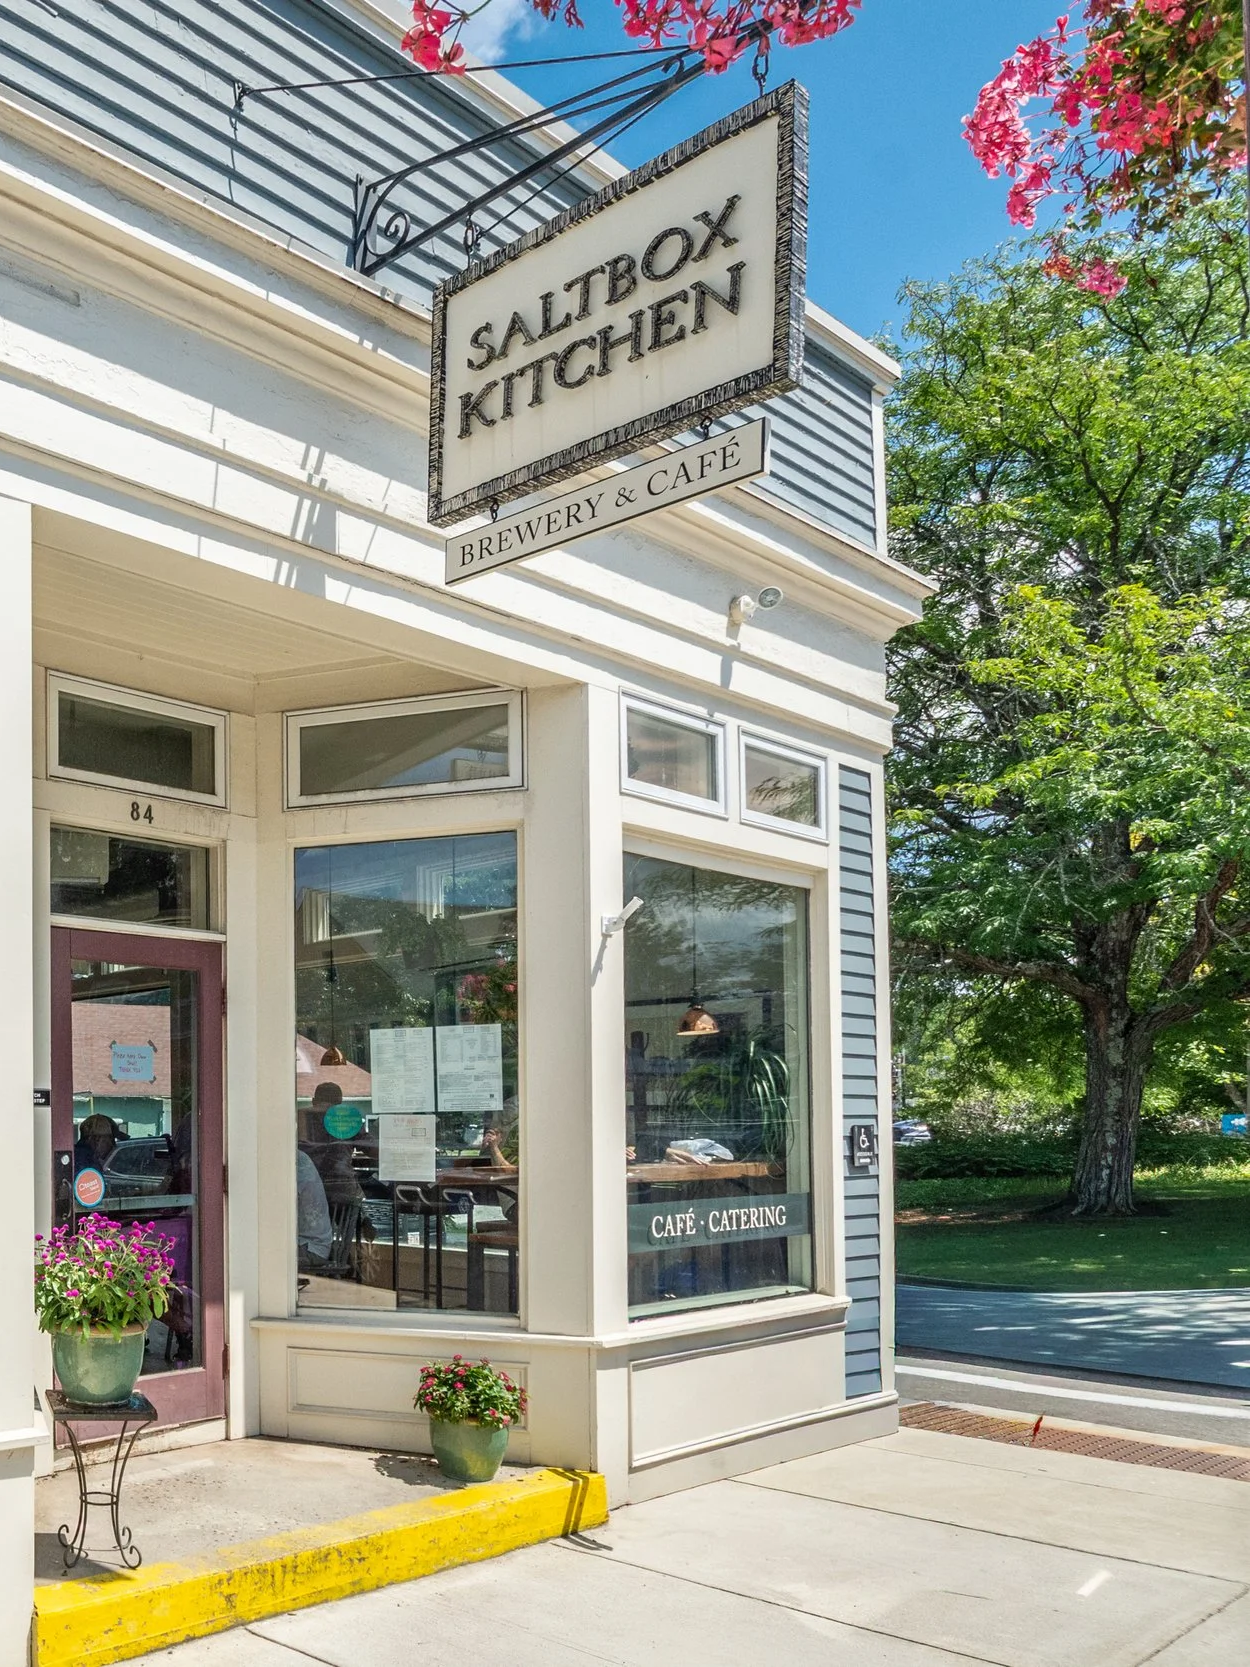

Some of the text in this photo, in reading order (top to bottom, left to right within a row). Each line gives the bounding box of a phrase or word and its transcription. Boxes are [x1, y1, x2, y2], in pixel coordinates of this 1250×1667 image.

[466, 193, 742, 372] SALTBOX
[457, 260, 746, 440] KITCHEN
[459, 434, 743, 568] BREWERY & CAFÉ
[129, 801, 154, 824] 84
[651, 1205, 787, 1239] CAFÉ CATERING
